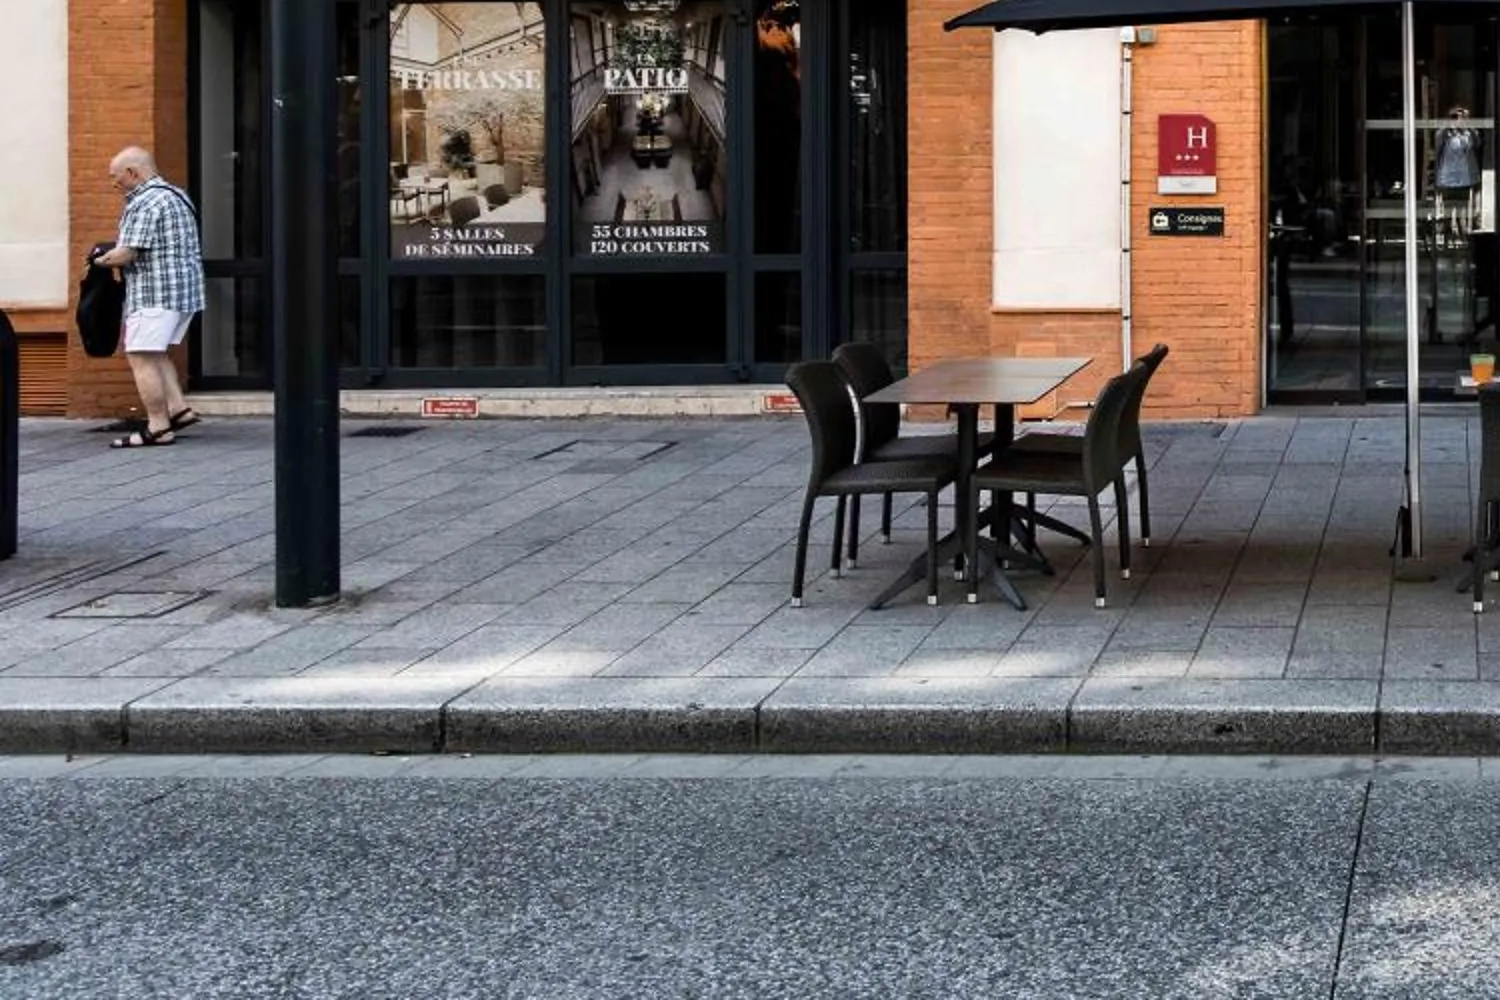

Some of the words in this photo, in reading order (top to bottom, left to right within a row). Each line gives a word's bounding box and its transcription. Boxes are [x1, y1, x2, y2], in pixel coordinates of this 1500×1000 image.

[402, 69, 541, 90] TERRASSE
[604, 67, 688, 89] PATIO
[1187, 126, 1208, 149] H
[430, 227, 440, 240] 5
[444, 228, 505, 240] SALLES
[592, 225, 611, 239] 55
[613, 226, 708, 238] CHAMBRES
[405, 244, 428, 257] DE
[431, 240, 535, 257] SÉMINAIRES
[591, 241, 618, 254] 120
[621, 241, 710, 253] COUVERTS
